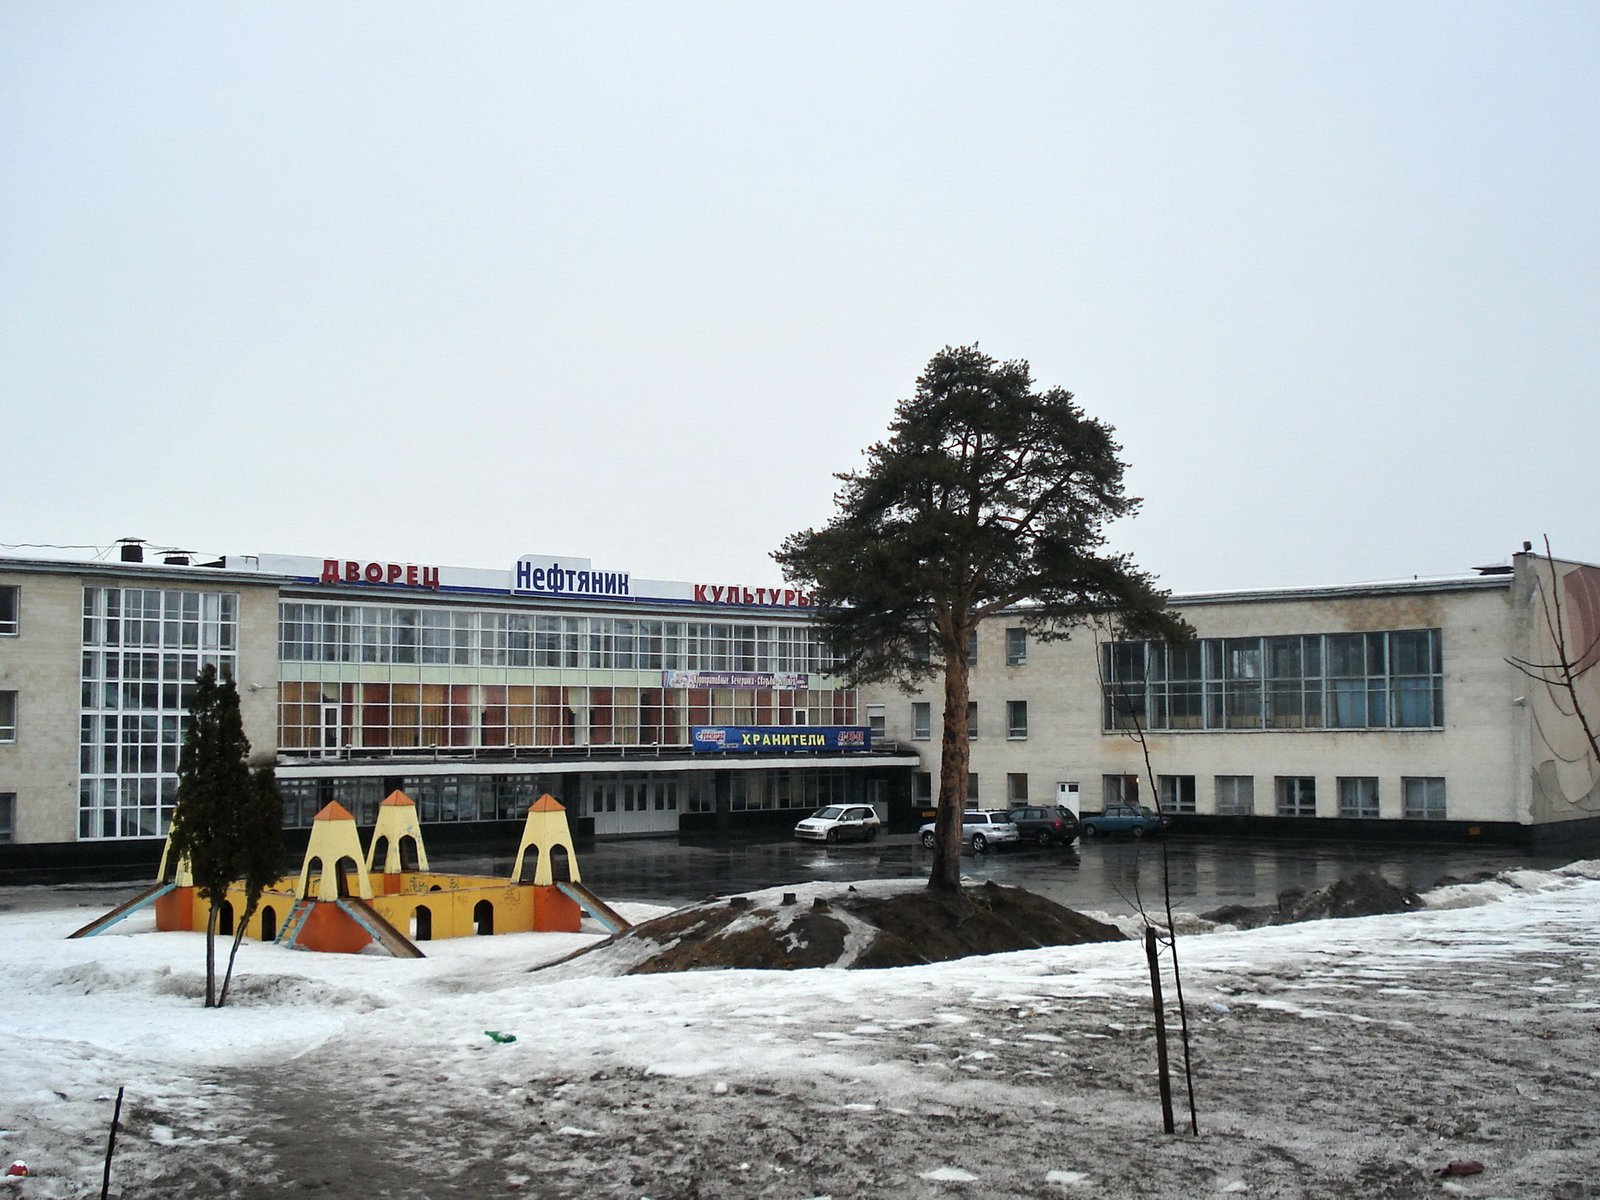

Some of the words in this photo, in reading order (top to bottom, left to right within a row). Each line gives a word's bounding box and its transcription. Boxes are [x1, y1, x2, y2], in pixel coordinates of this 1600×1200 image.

[321, 559, 439, 590] ДВОРЕЦ
[516, 560, 630, 595] Нефтяник
[741, 733, 825, 746] ХРАНИТЕЛИ
